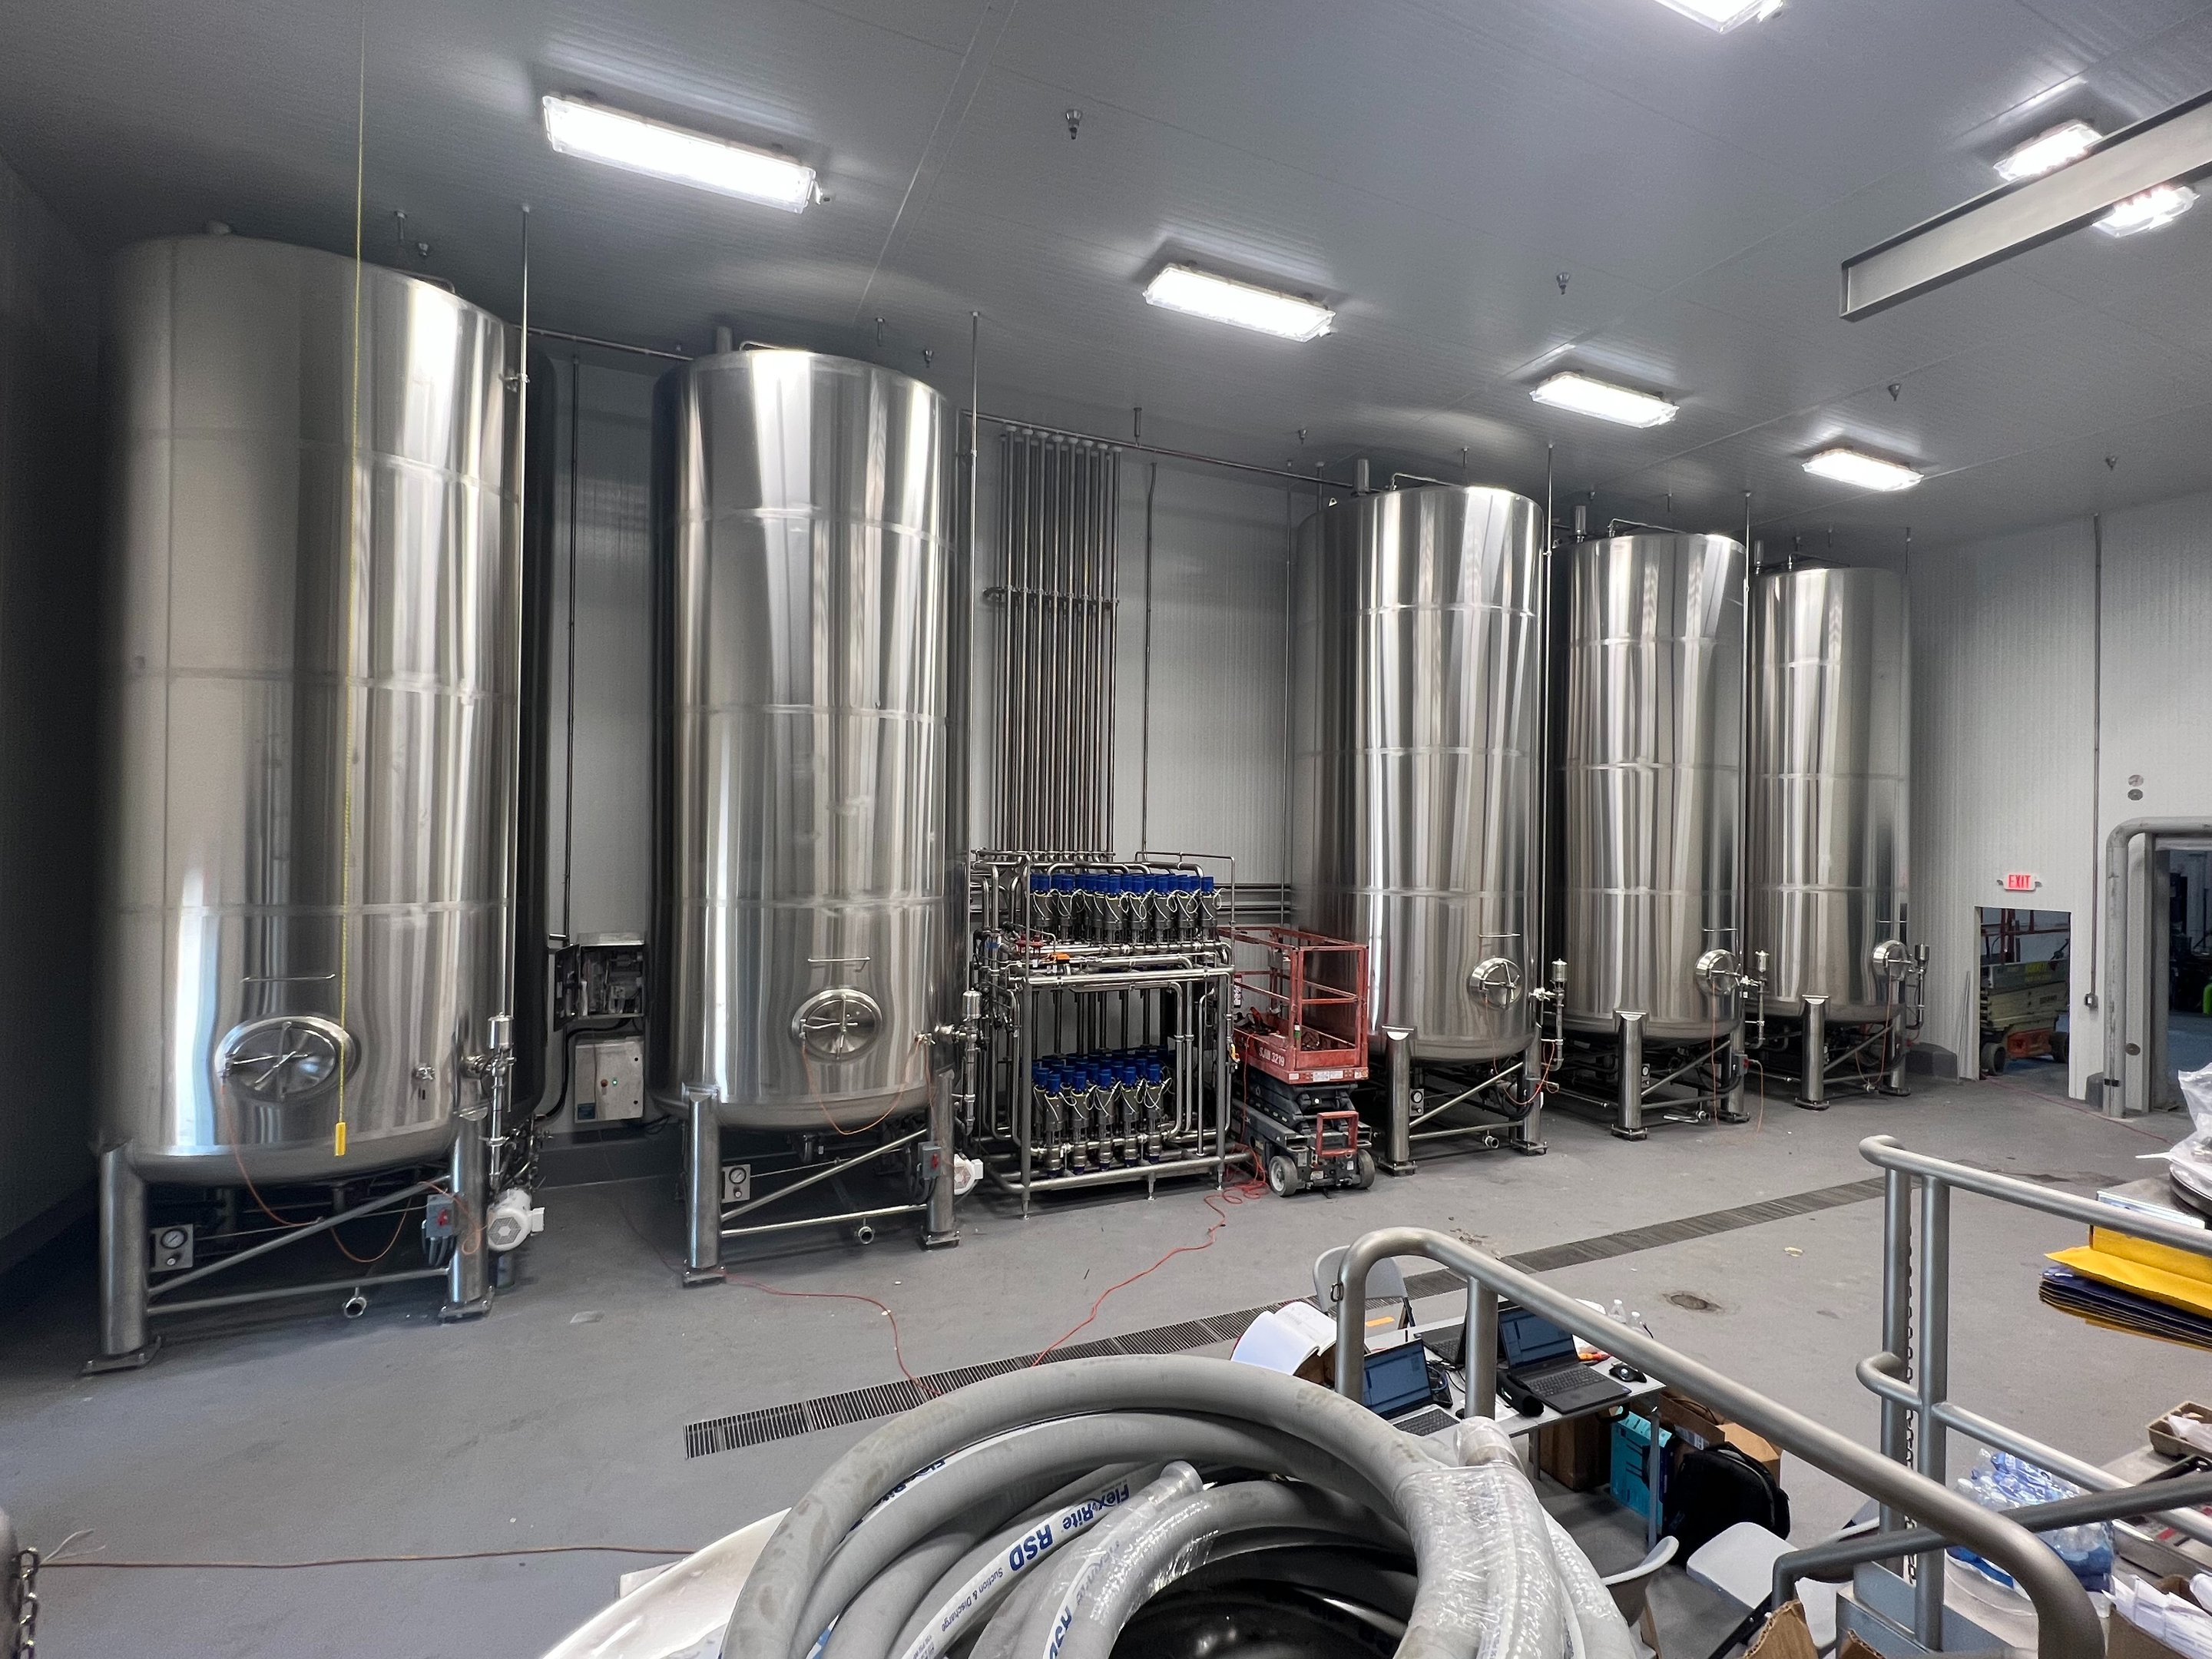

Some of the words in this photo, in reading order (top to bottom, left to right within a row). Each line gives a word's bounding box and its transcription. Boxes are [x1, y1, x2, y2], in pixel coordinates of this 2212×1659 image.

[2008, 874, 2031, 889] EXIT
[1271, 1051, 1285, 1067] 3219
[1009, 1525, 1053, 1571] RSD
[979, 1568, 1003, 1593] Suction
[972, 1590, 978, 1600] &
[942, 1596, 972, 1631] Discharge
